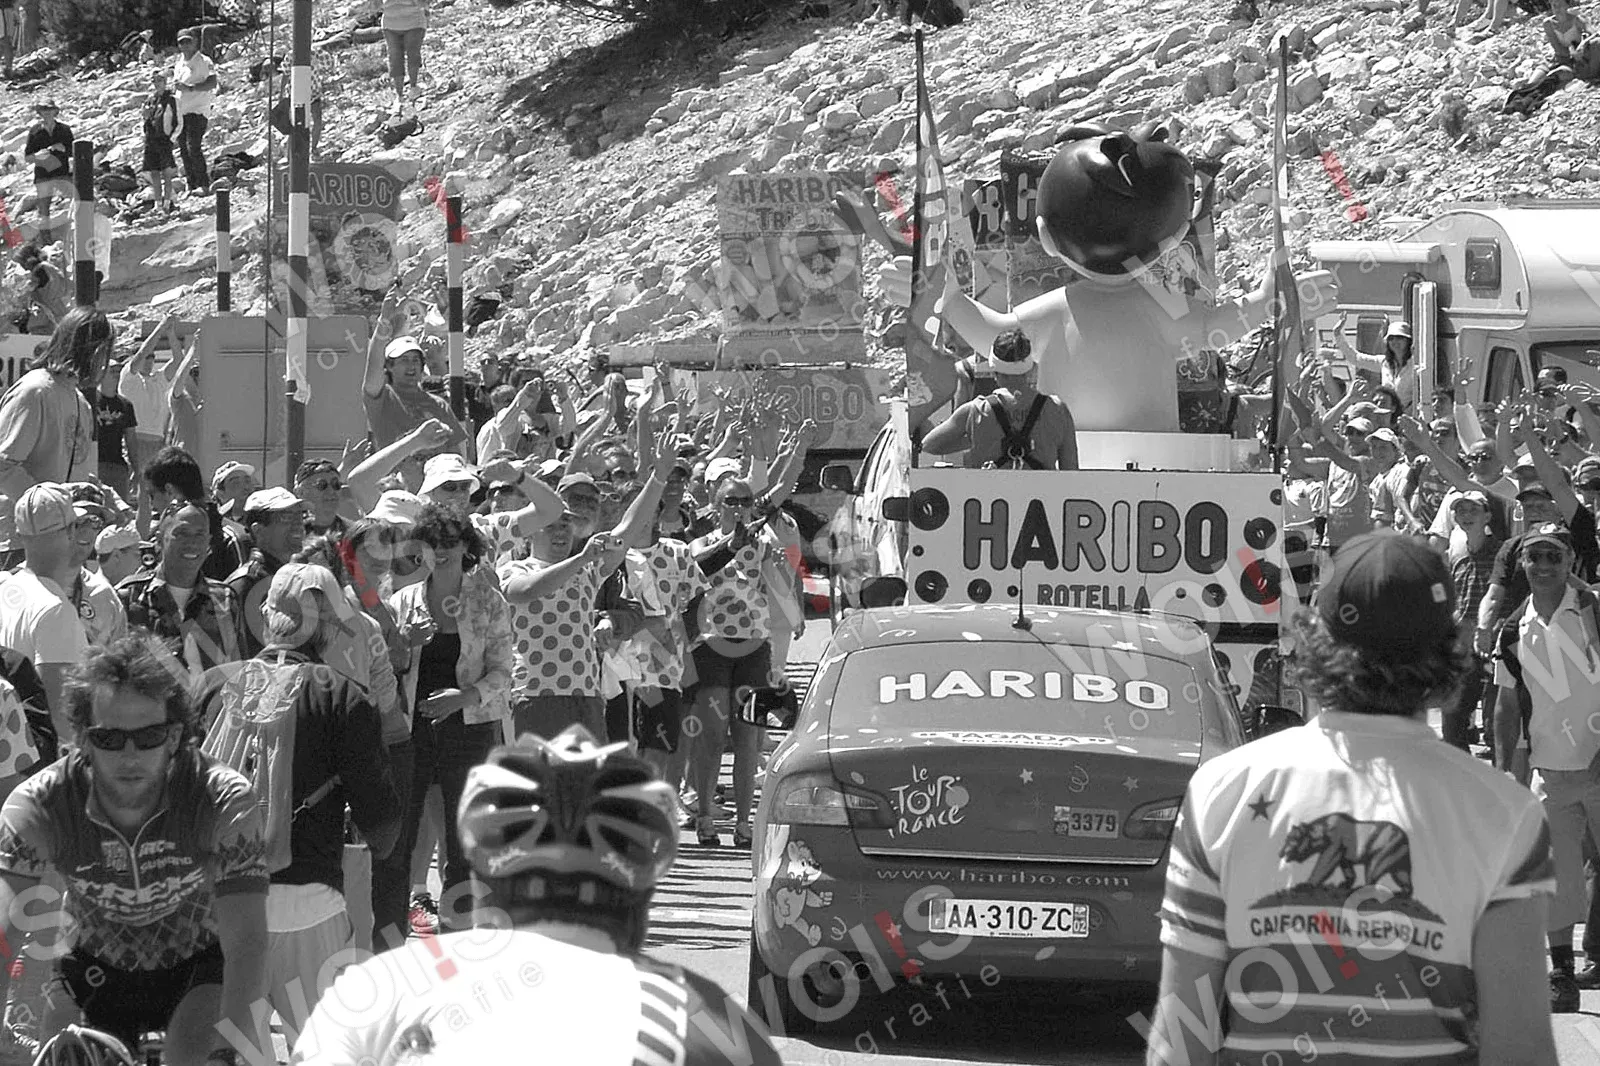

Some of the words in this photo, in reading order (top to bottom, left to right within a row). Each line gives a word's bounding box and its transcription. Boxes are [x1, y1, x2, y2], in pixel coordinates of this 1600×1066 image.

[281, 172, 394, 208] ARIBO
[775, 383, 866, 424] RIBO
[963, 498, 1228, 574] HARIBO
[1037, 583, 1151, 614] ROTELLA
[879, 670, 1169, 709] HARIBO
[1071, 812, 1117, 833] 3379
[877, 868, 1130, 888] www.haribo.com
[947, 903, 1073, 932] AA-310-ZC
